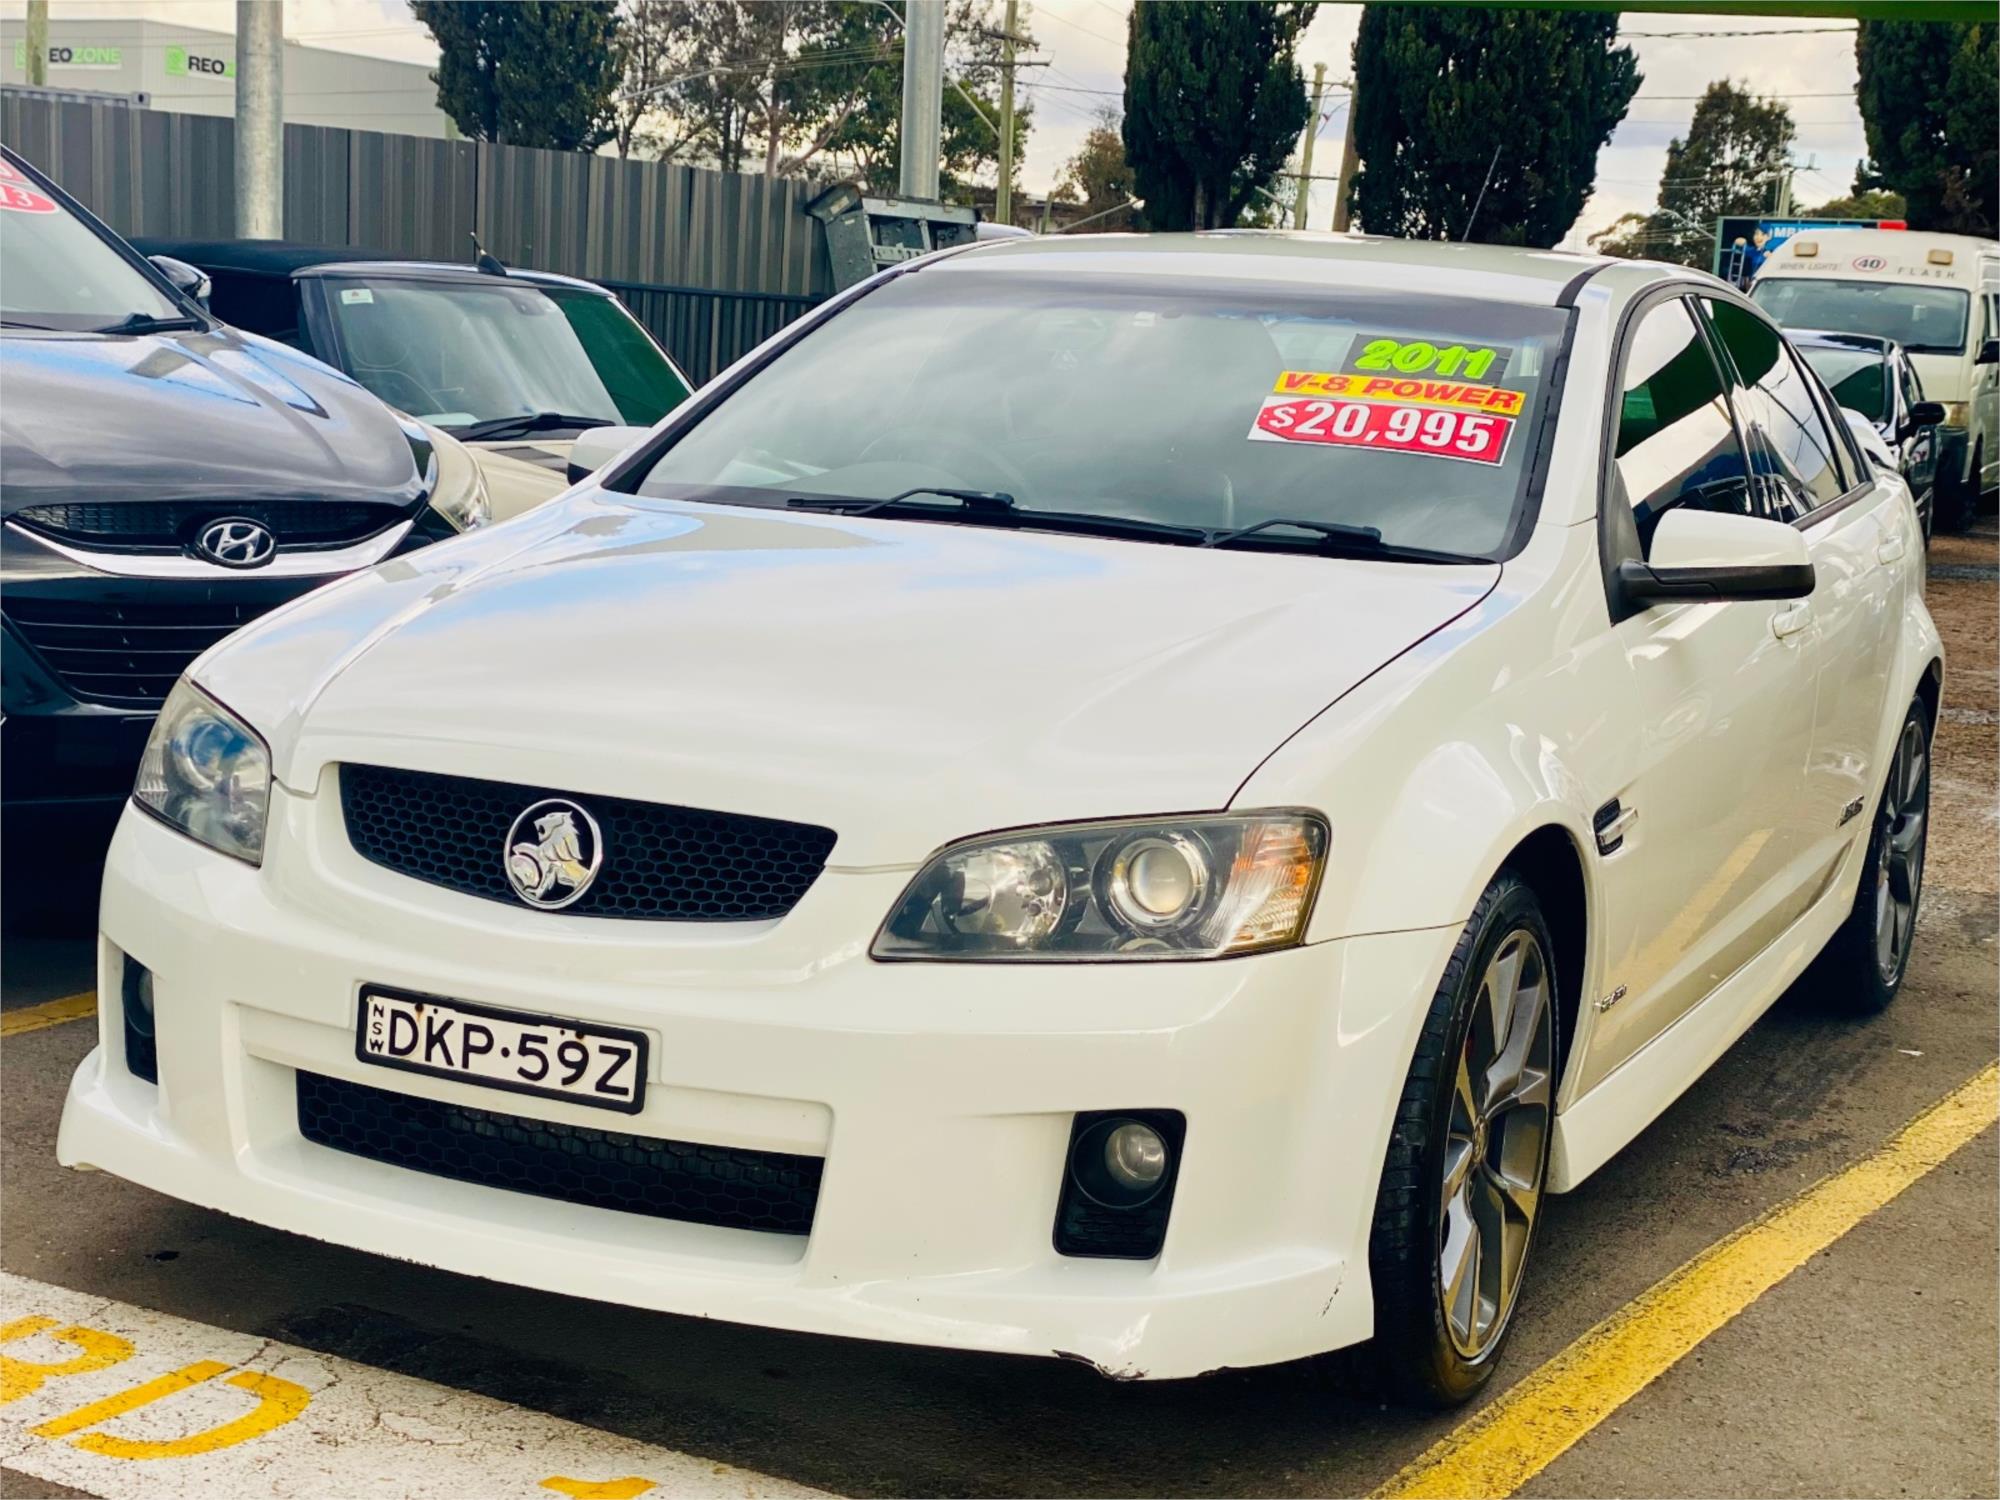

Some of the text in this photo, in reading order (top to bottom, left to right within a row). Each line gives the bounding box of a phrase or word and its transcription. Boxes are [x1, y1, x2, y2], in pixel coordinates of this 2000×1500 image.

[48, 47, 122, 64] EOZONE
[1858, 258, 1882, 269] 40
[1897, 266, 1956, 279] FLASH
[1354, 339, 1497, 380] 2011
[1283, 373, 1519, 410] V-8 POWER
[1268, 401, 1495, 453] $20,995
